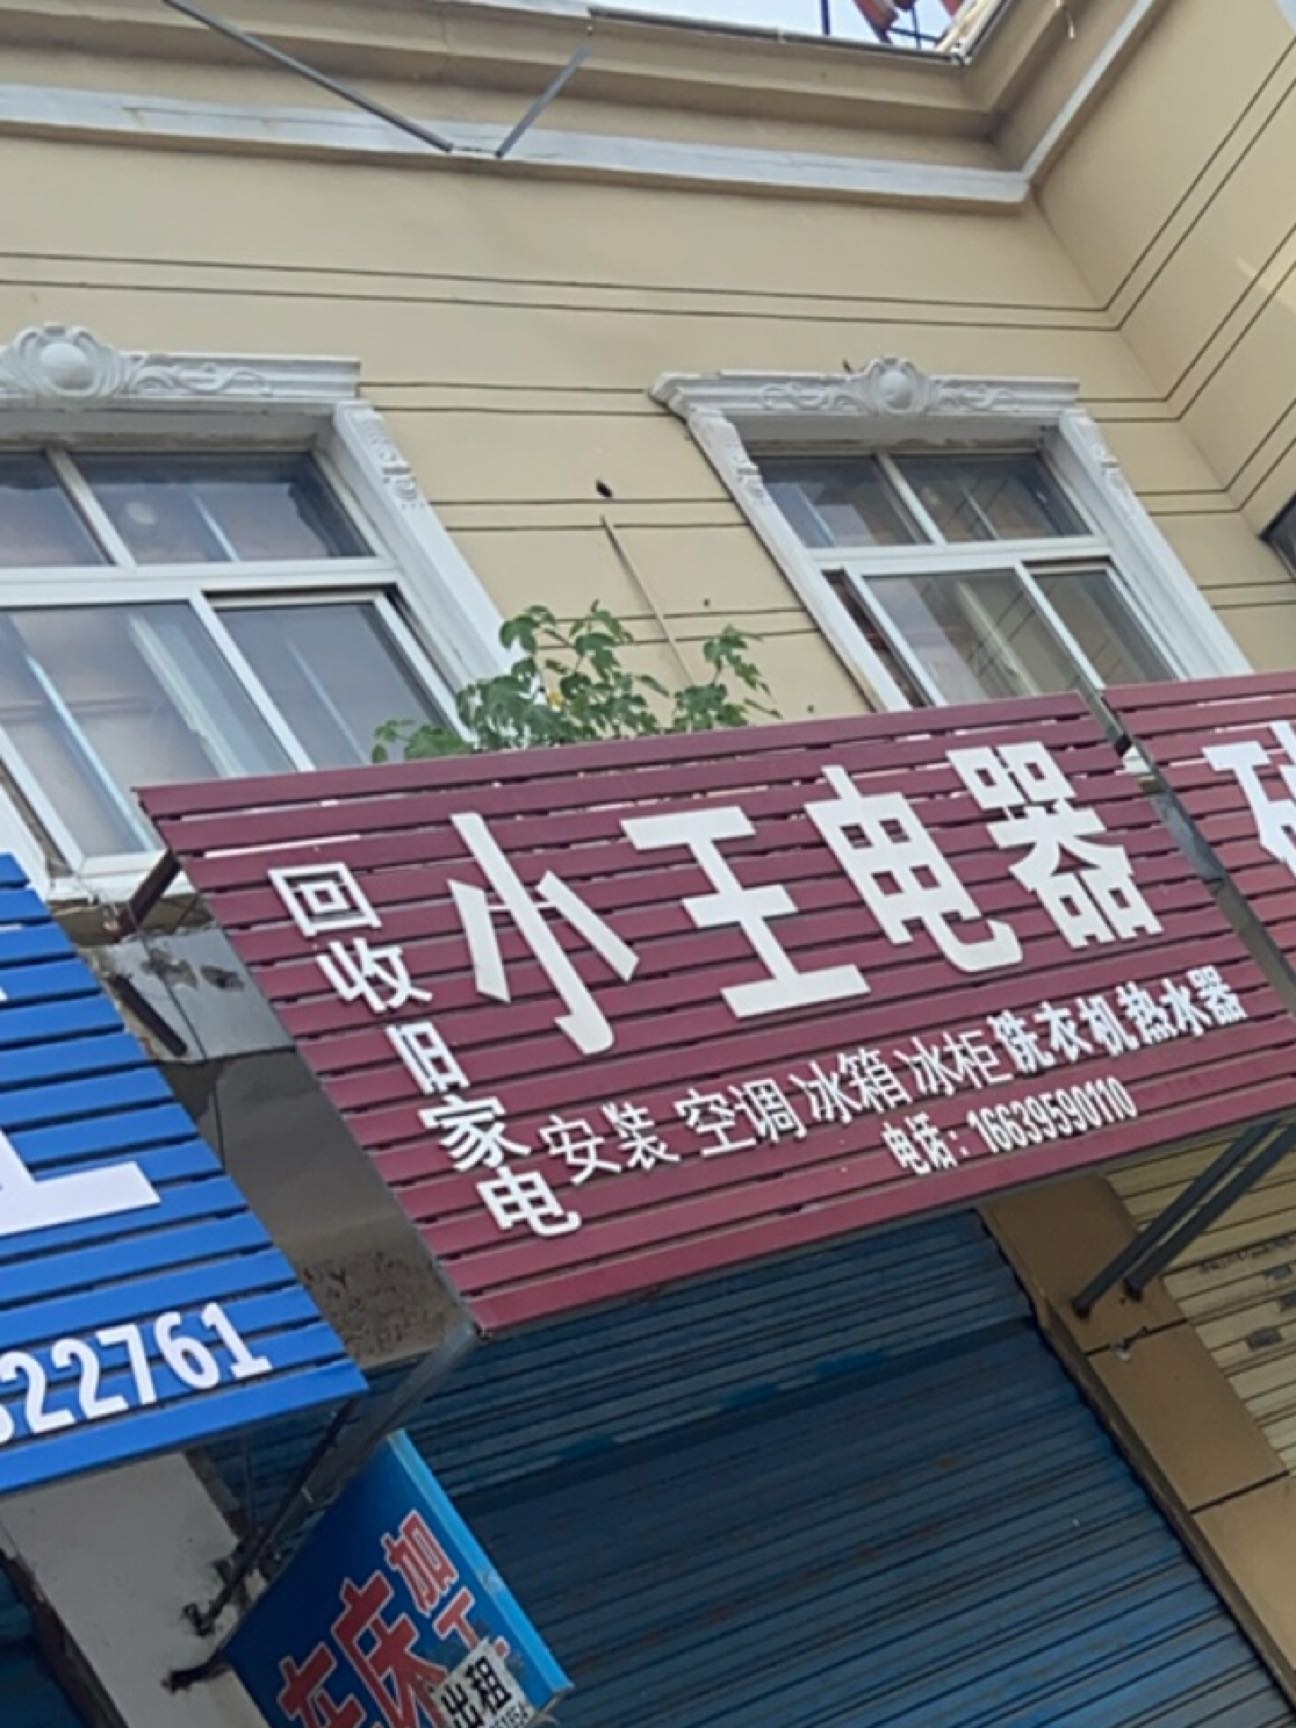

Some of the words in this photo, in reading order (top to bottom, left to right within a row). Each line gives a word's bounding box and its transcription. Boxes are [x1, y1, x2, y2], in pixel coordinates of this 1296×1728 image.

[268, 861, 582, 1237] 回收旧家电
[449, 740, 1164, 1054] 小王电器
[539, 1104, 680, 1184] 安装
[674, 1075, 807, 1160] 空调
